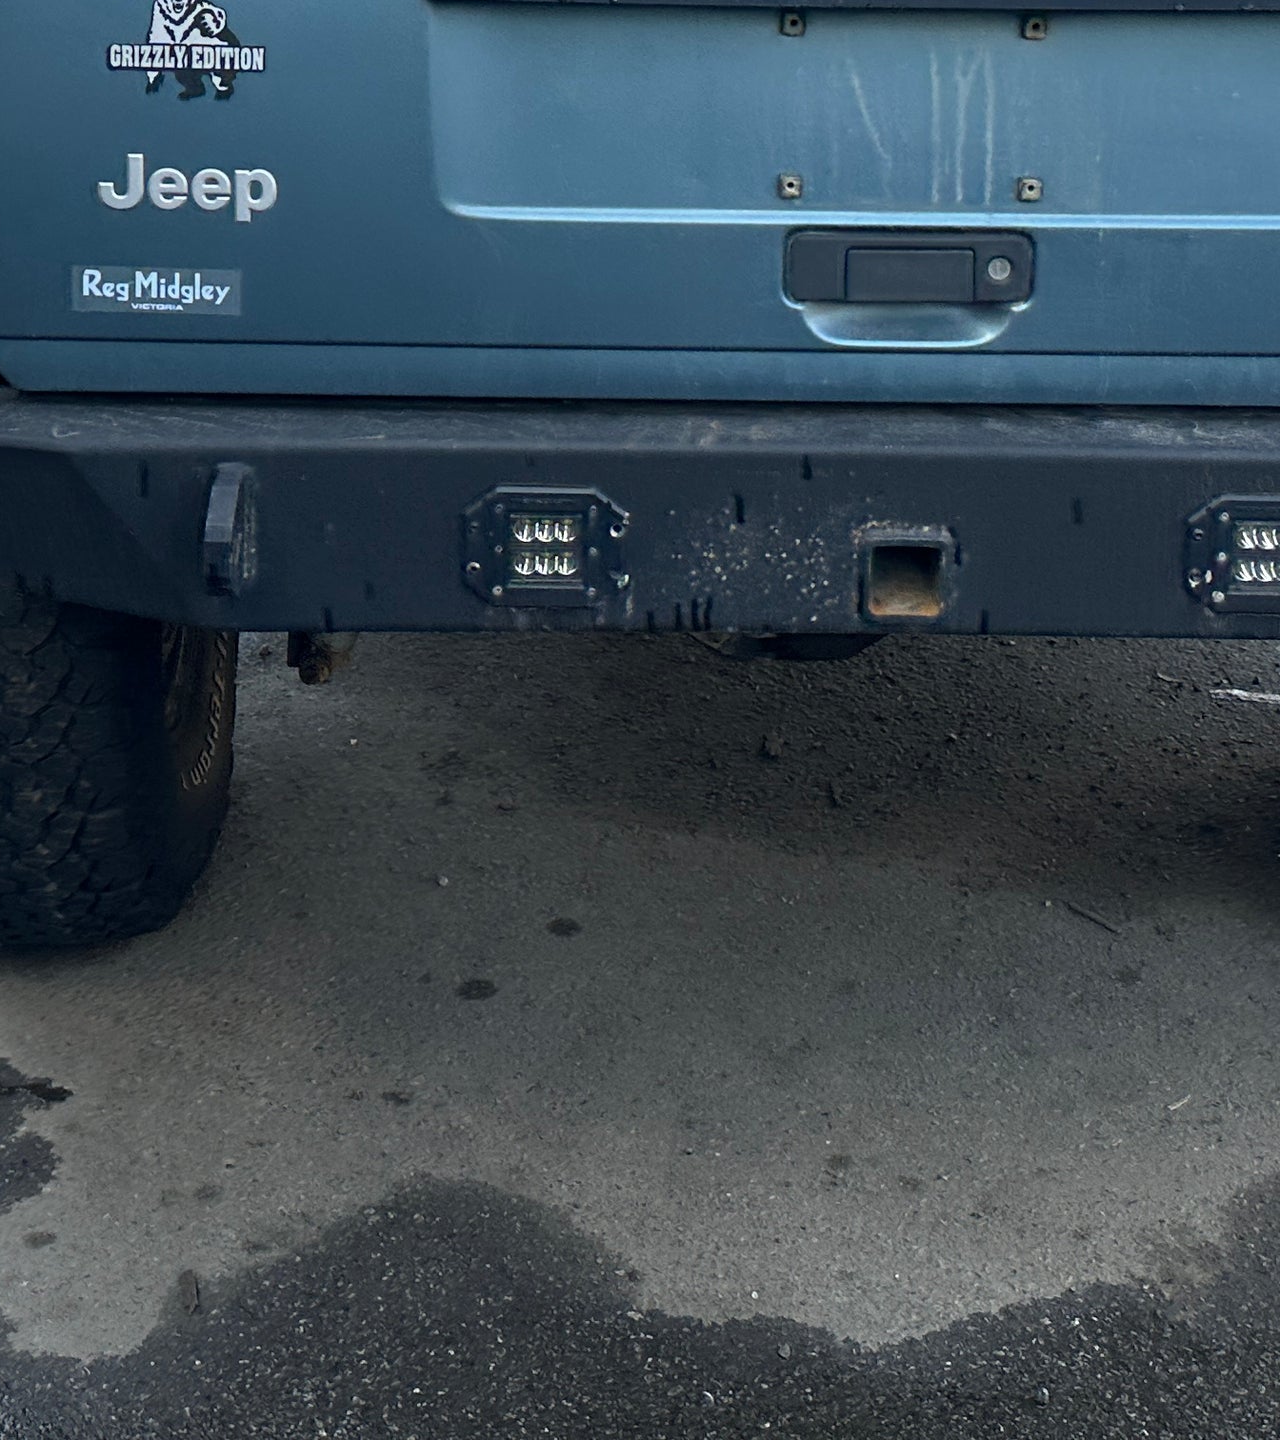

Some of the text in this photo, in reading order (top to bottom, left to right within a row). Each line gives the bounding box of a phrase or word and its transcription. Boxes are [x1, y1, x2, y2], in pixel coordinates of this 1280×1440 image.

[110, 44, 265, 71] GRIZZLY EDITION
[97, 153, 278, 223] Jeep
[82, 269, 231, 305] Reg Midgley
[131, 303, 184, 311] VICTORIA
